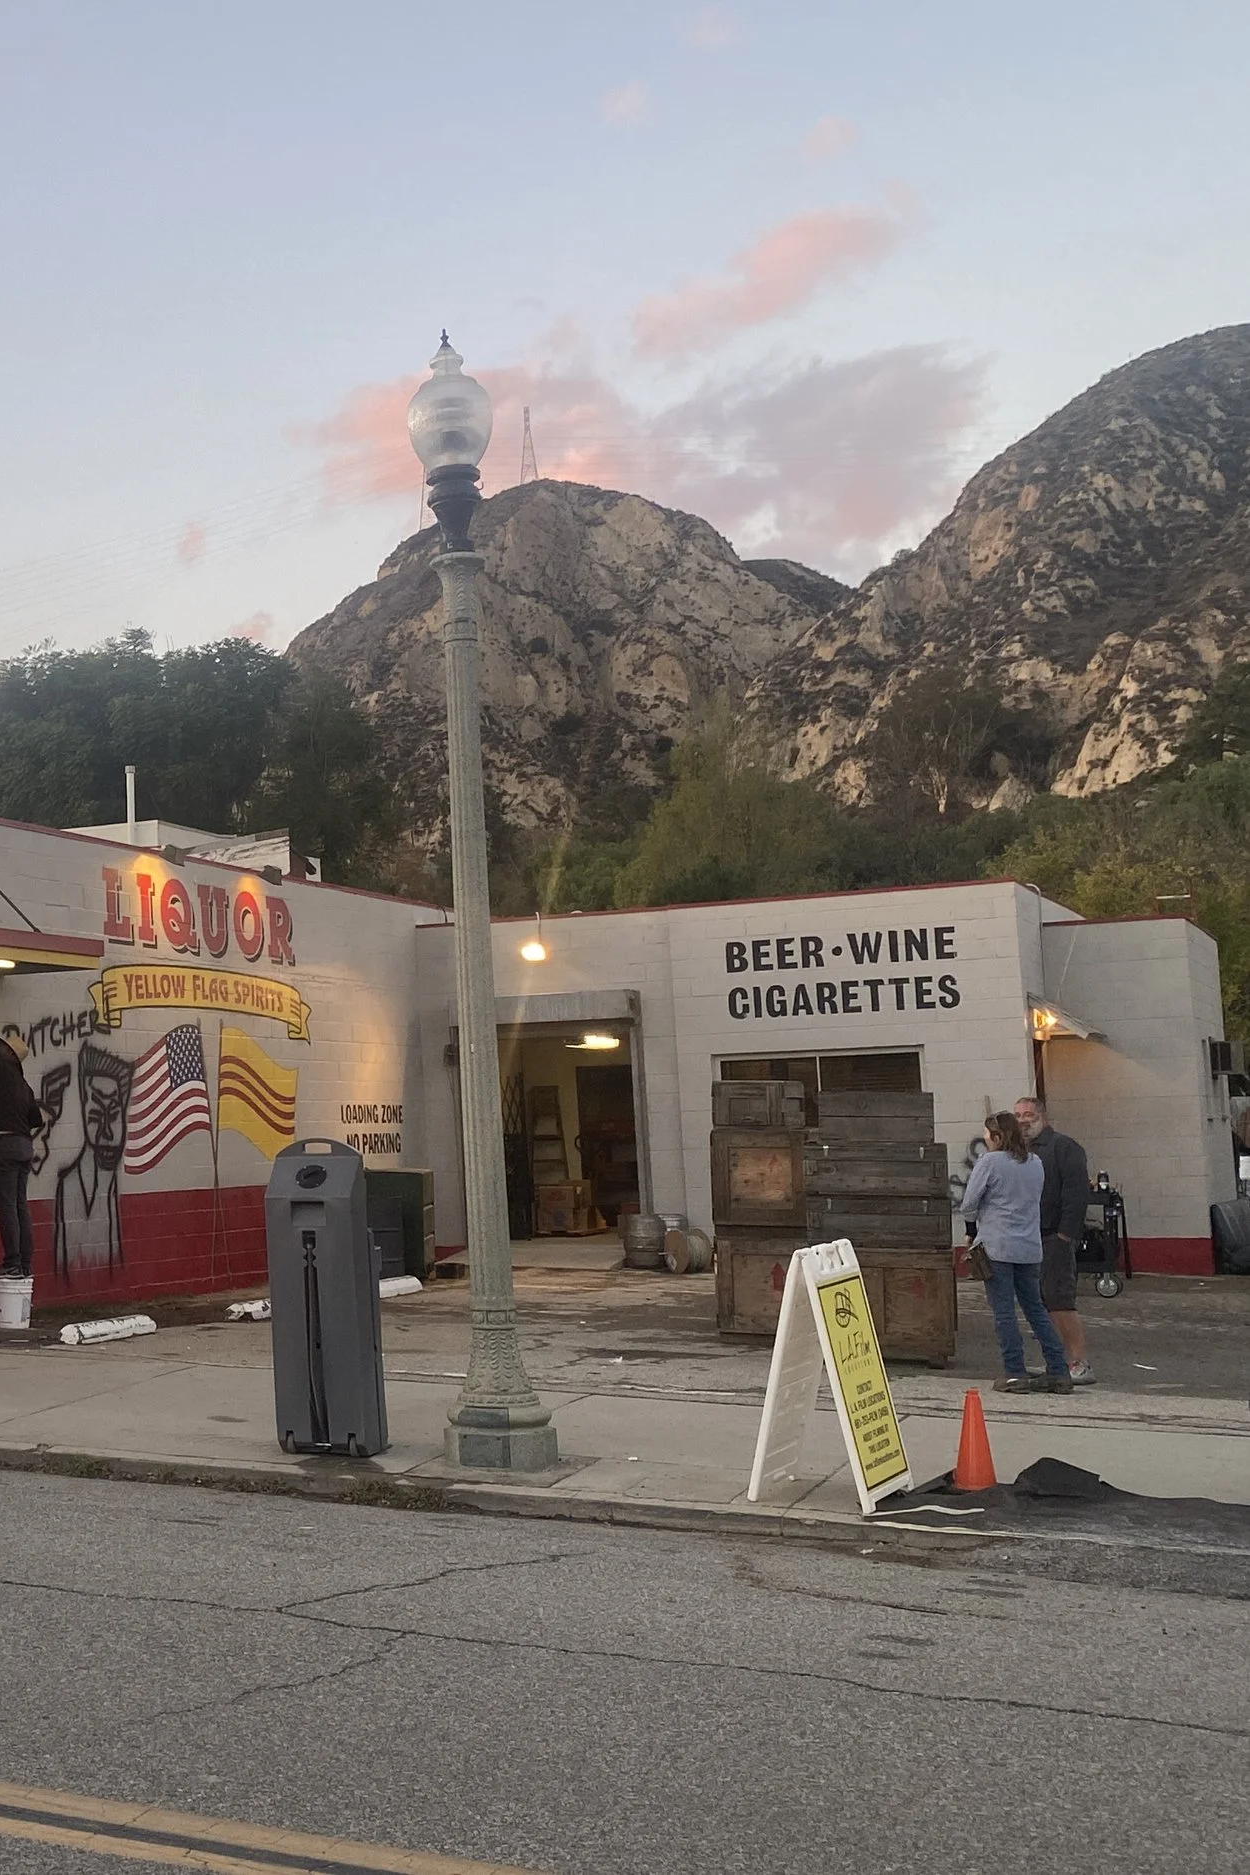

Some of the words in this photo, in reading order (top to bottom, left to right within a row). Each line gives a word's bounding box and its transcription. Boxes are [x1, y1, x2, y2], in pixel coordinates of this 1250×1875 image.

[102, 867, 296, 967] LIQUOR
[123, 973, 186, 1003] YELLOW
[192, 974, 230, 1004] FLAG
[233, 980, 285, 1013] SPIRITS
[728, 974, 961, 1020] CIGARETTES
[340, 1104, 379, 1124] LOADING
[381, 1104, 404, 1124] ZONE
[346, 1133, 360, 1152] NO
[362, 1132, 402, 1154] PARKING
